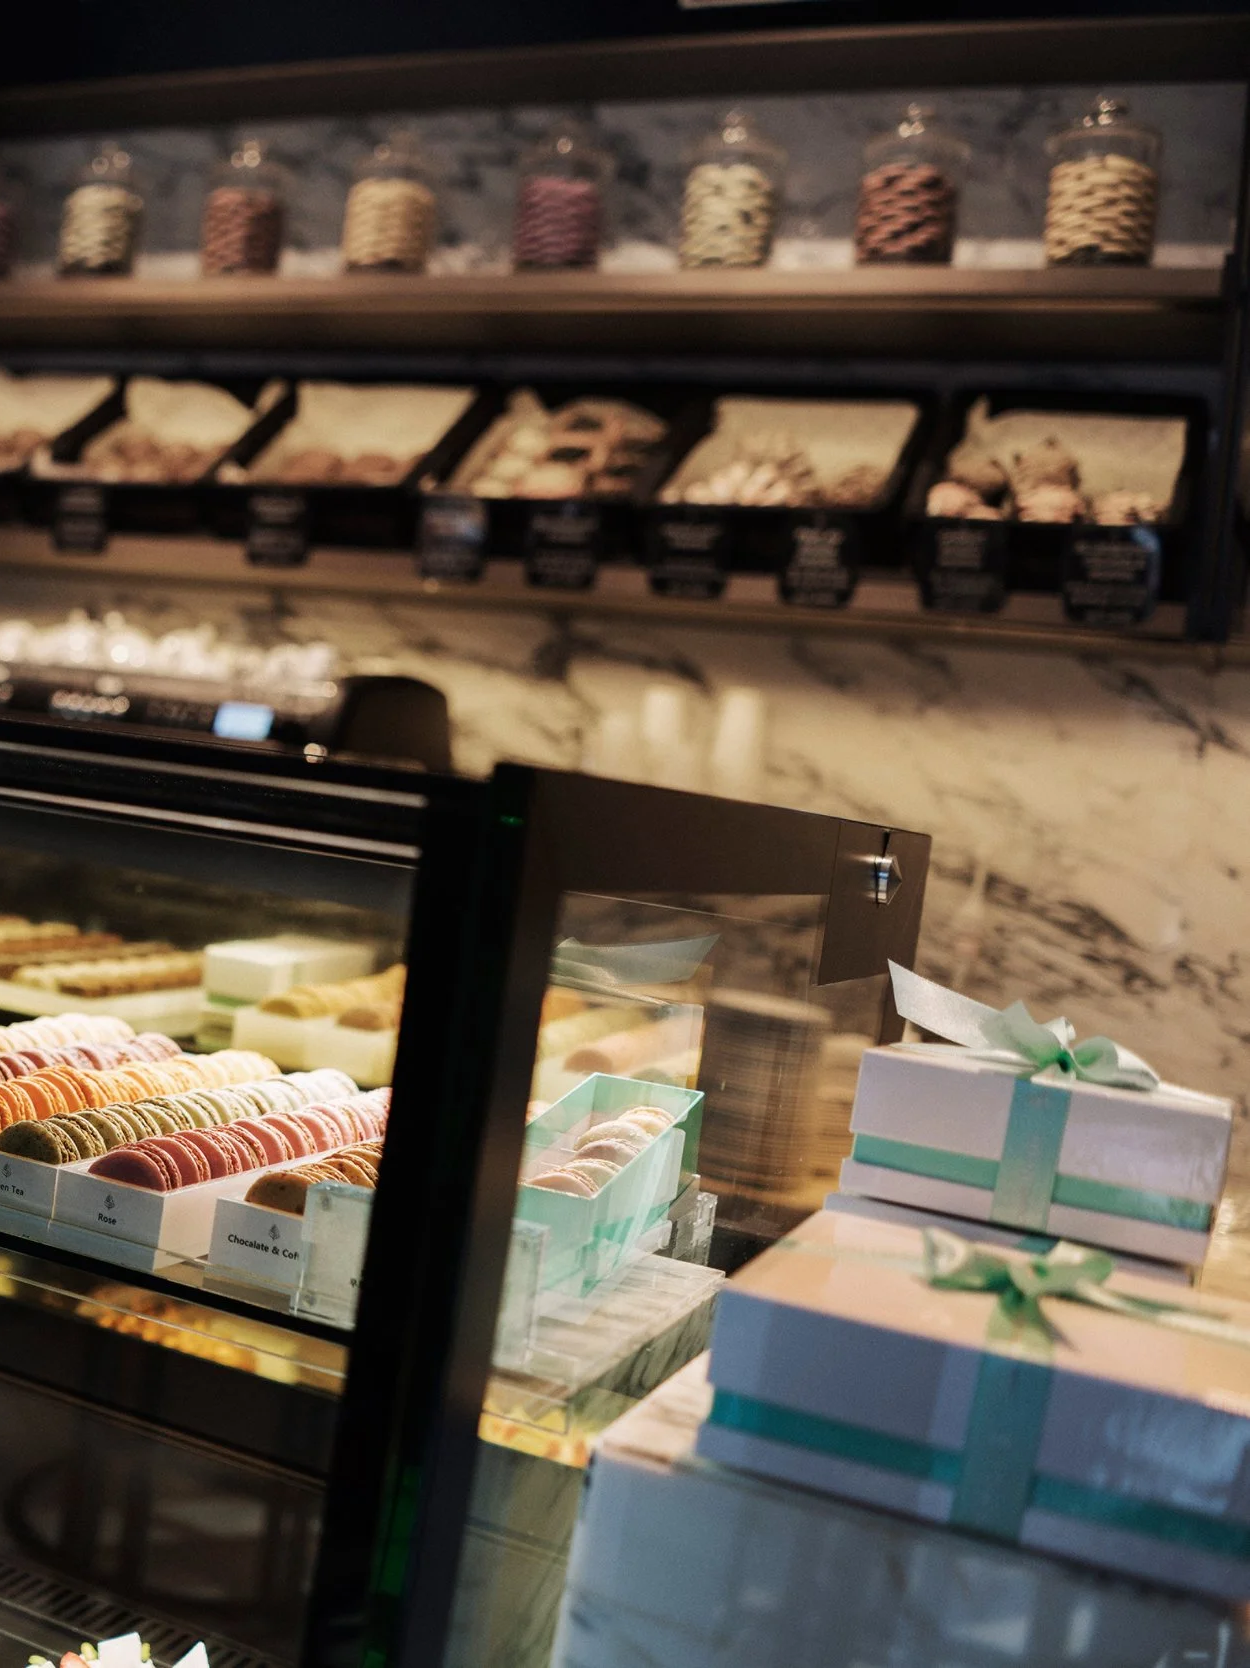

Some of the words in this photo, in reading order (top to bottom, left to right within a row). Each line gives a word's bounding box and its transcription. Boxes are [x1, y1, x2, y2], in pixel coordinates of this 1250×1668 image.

[11, 1185, 24, 1196] Tea
[97, 1212, 117, 1226] Rose
[271, 1245, 280, 1255] &
